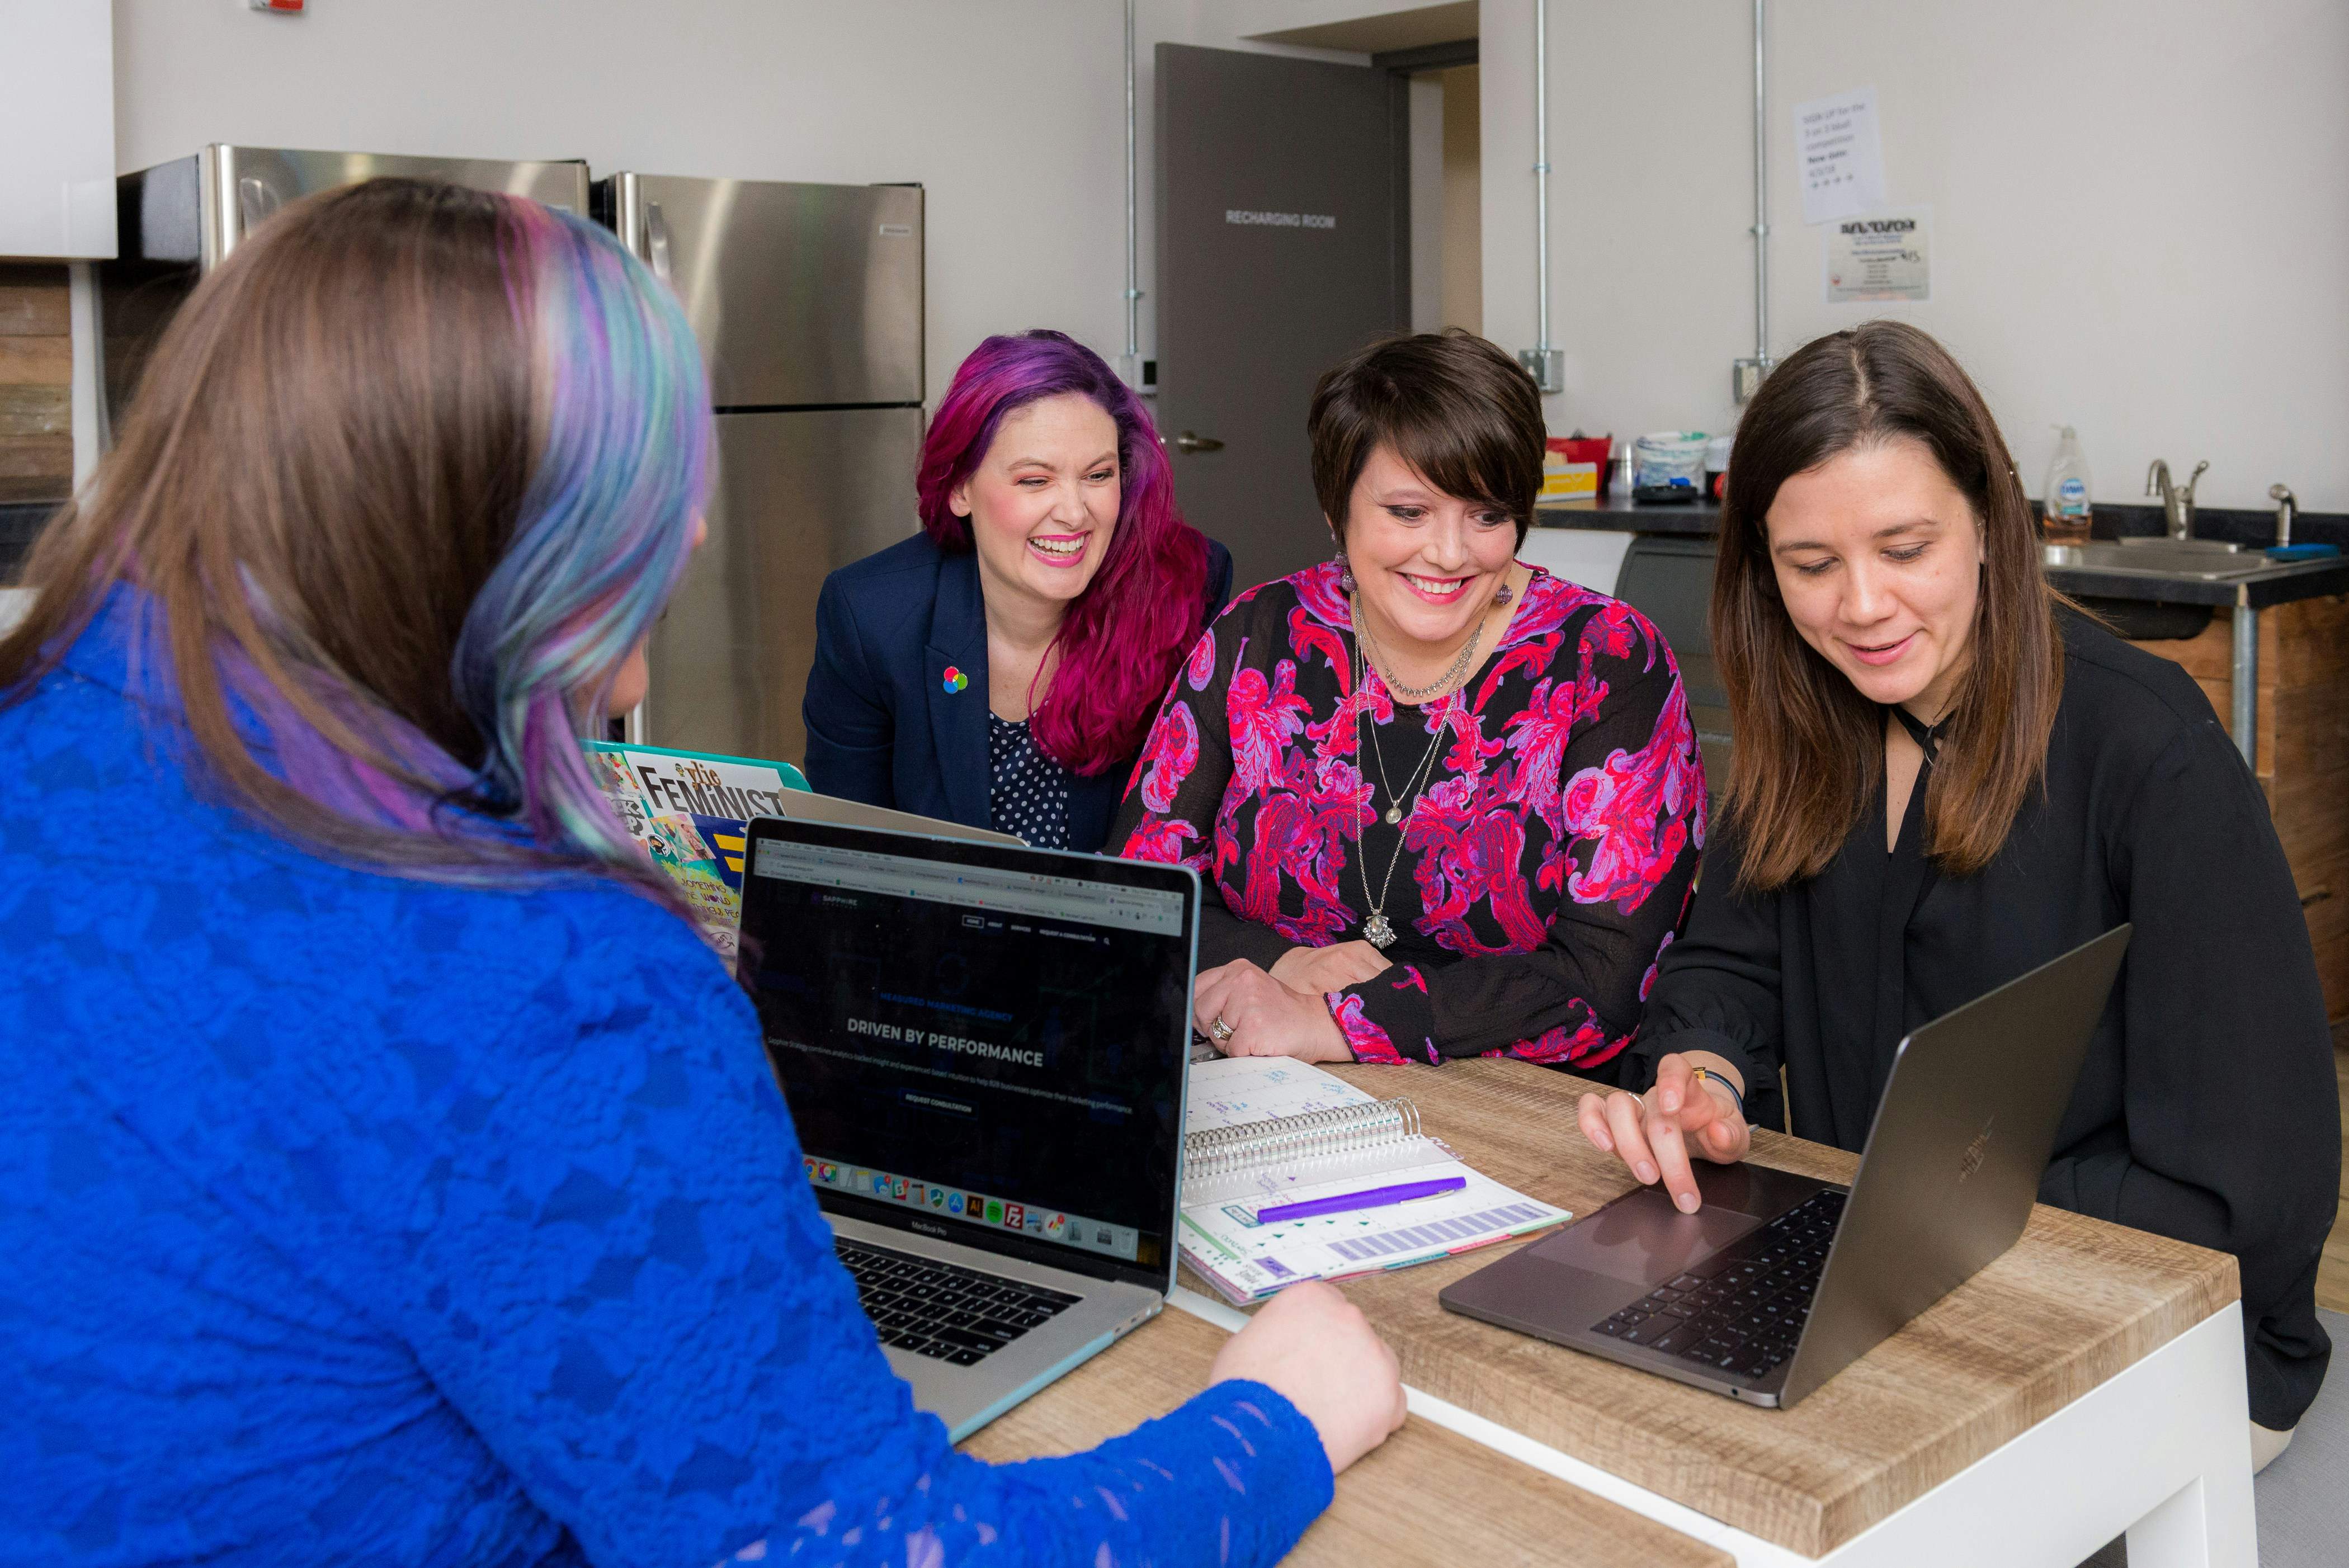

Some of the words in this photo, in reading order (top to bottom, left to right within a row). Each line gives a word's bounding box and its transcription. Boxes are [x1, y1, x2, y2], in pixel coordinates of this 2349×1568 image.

[1226, 210, 1300, 227] RECHARGING
[1302, 214, 1336, 229] ROOM
[847, 1018, 901, 1040] DRIVEN
[905, 1029, 925, 1045] BY
[928, 1033, 1044, 1068] PERFORMANCE
